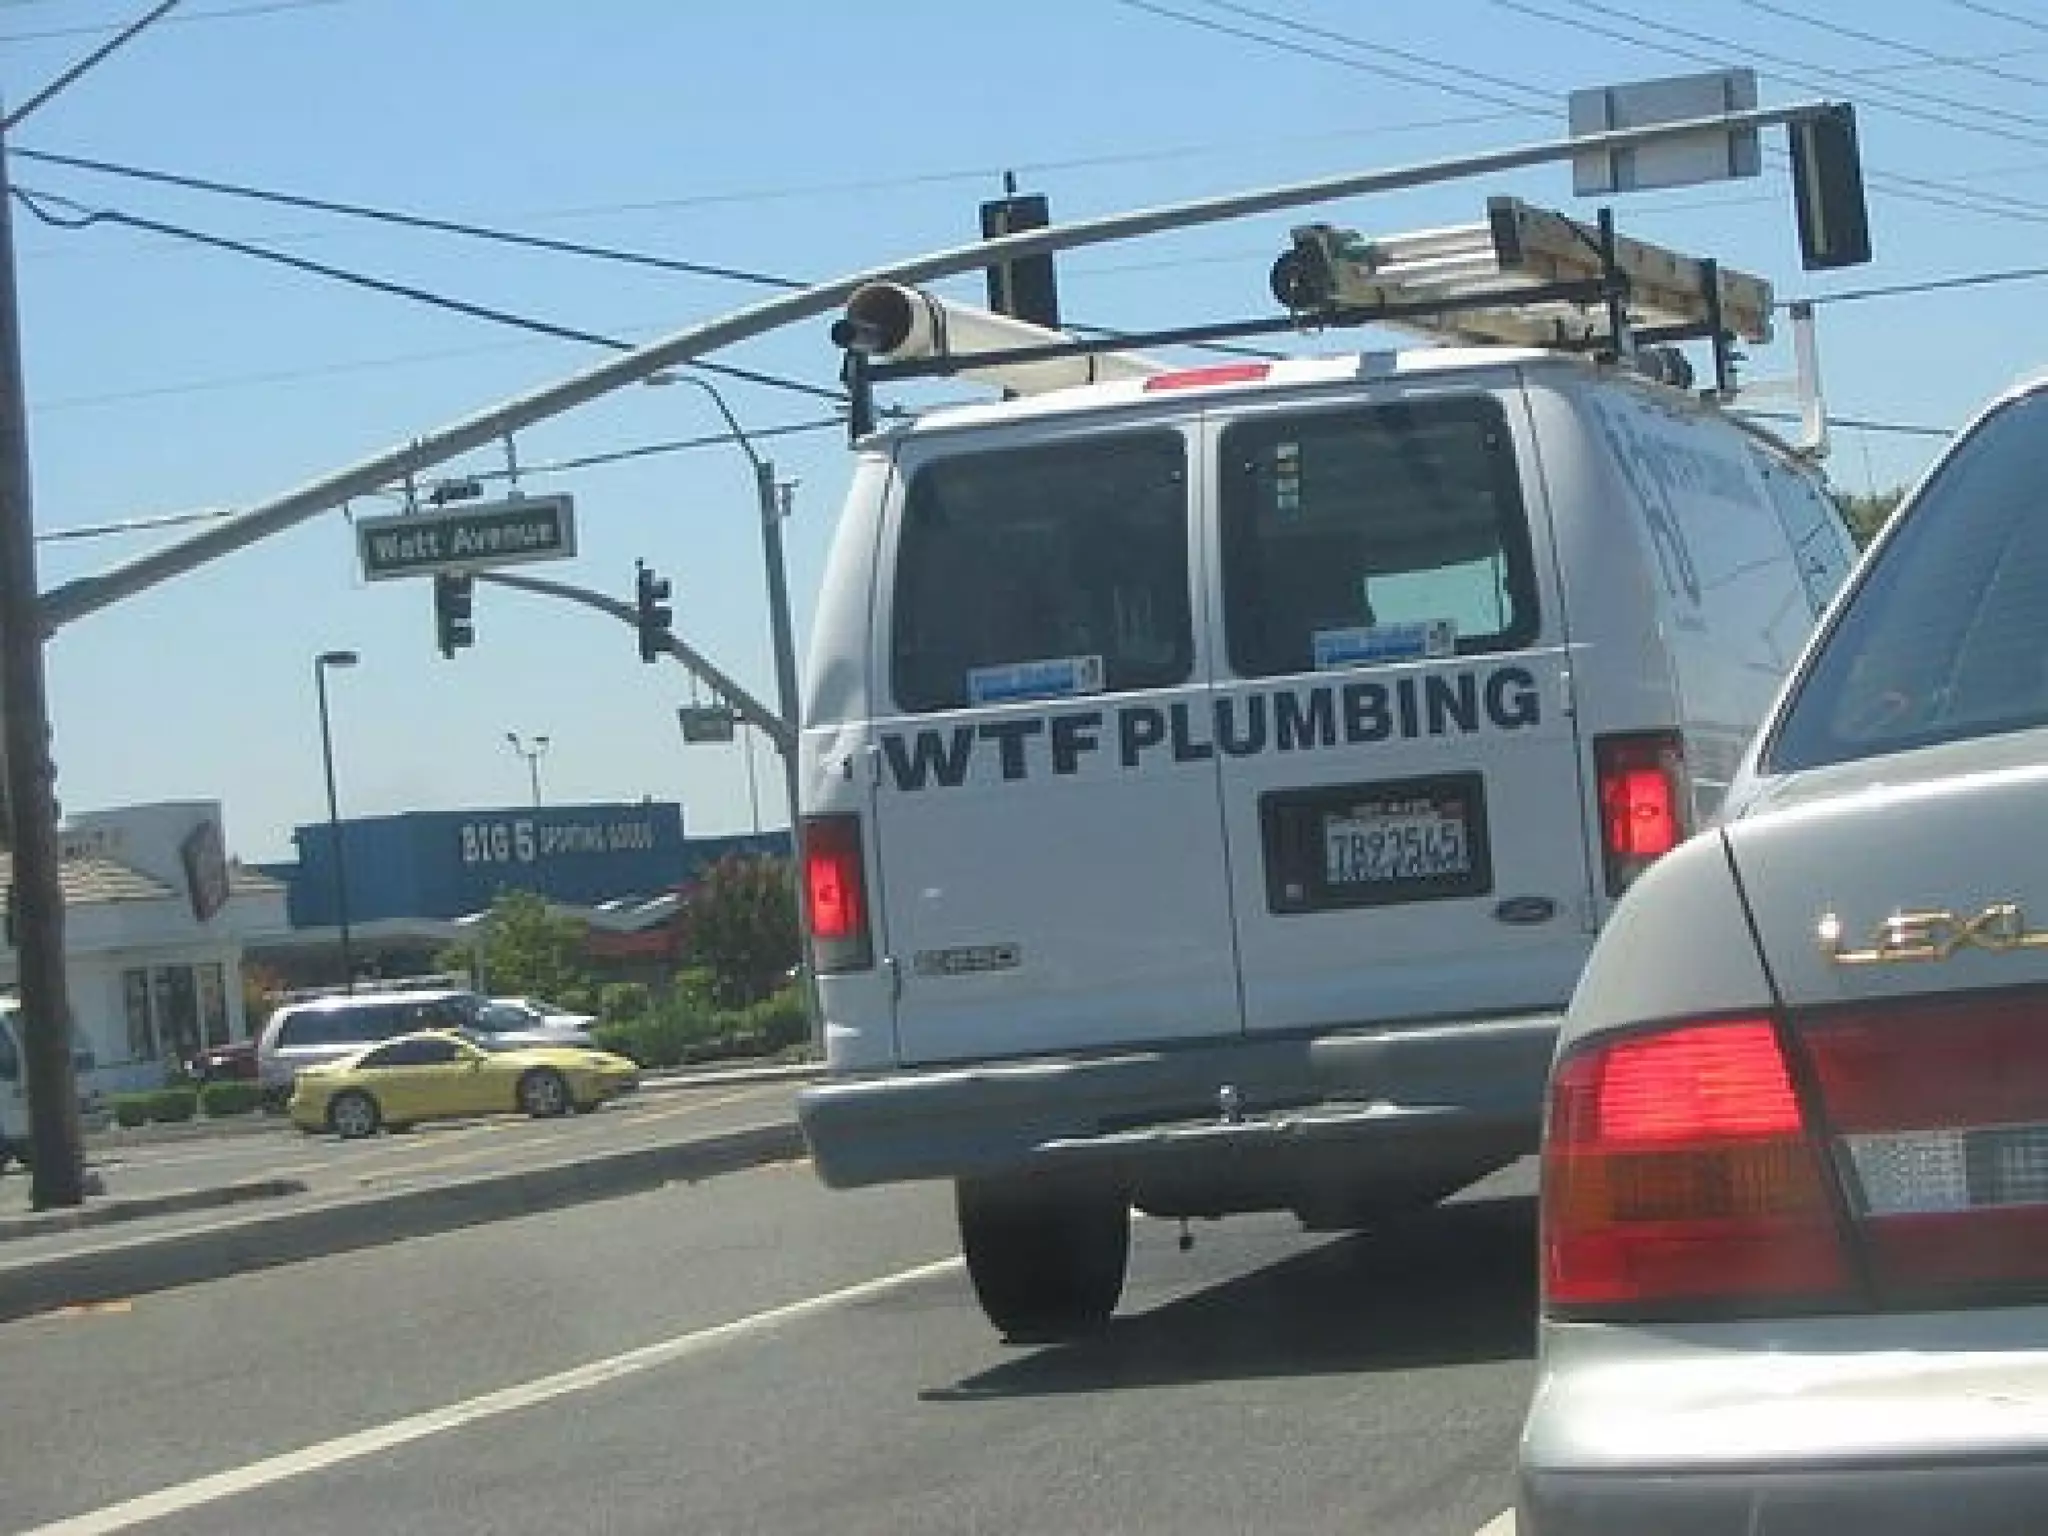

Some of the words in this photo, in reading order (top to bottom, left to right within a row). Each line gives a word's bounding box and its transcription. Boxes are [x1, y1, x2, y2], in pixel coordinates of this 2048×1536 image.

[881, 712, 1102, 791] WTF
[1117, 669, 1537, 767] PLUMBING
[513, 819, 534, 861] 5
